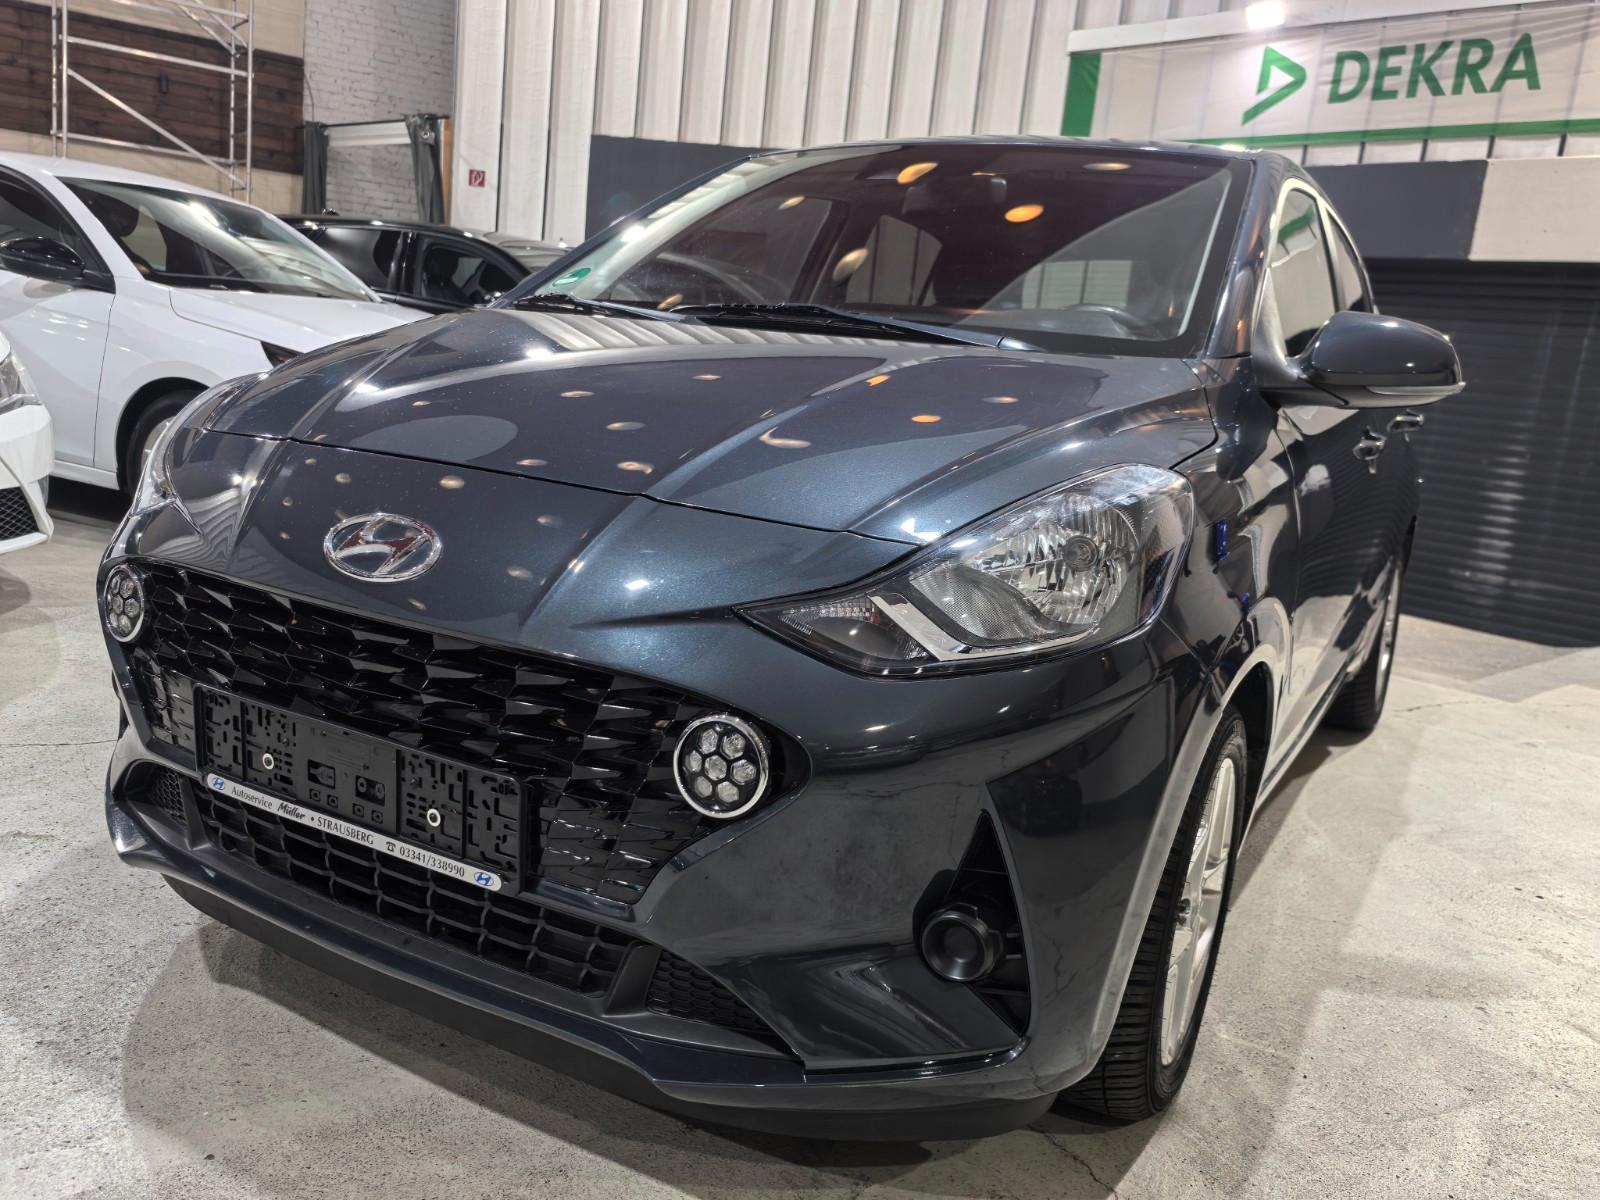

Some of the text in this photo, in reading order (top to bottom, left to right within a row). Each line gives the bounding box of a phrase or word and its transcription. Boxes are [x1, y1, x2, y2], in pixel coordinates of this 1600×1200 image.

[1328, 32, 1541, 104] DEKRA
[231, 786, 465, 877] Autoservice Müller STRAUSBERG 03341/338990
